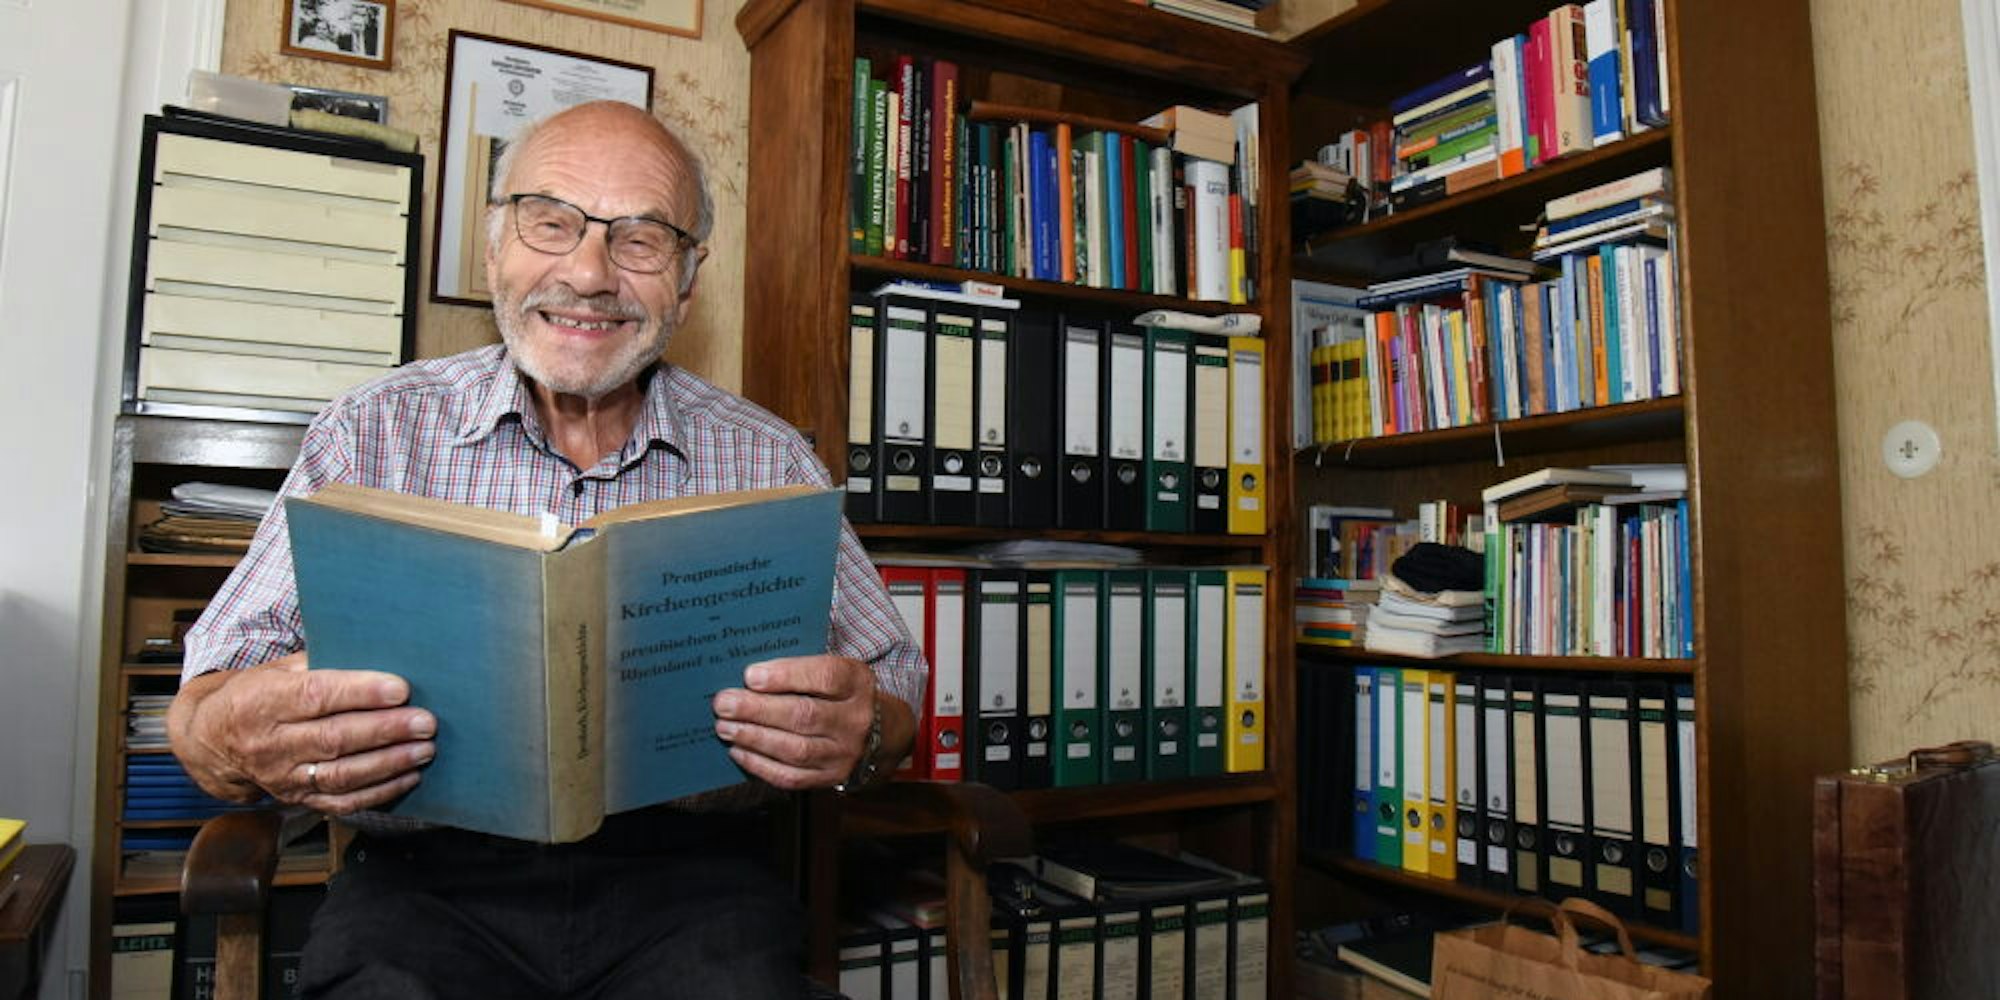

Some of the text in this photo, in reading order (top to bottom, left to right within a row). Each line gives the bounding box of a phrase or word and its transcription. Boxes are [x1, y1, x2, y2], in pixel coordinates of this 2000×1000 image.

[872, 90, 887, 225] BLUMEN UND GARTEN
[661, 556, 772, 587] Pragmatische
[621, 575, 806, 620] Kirchengeschichte
[722, 615, 801, 639] Provinzen
[621, 655, 703, 682] Rheinland
[728, 637, 799, 657] Westfalen
